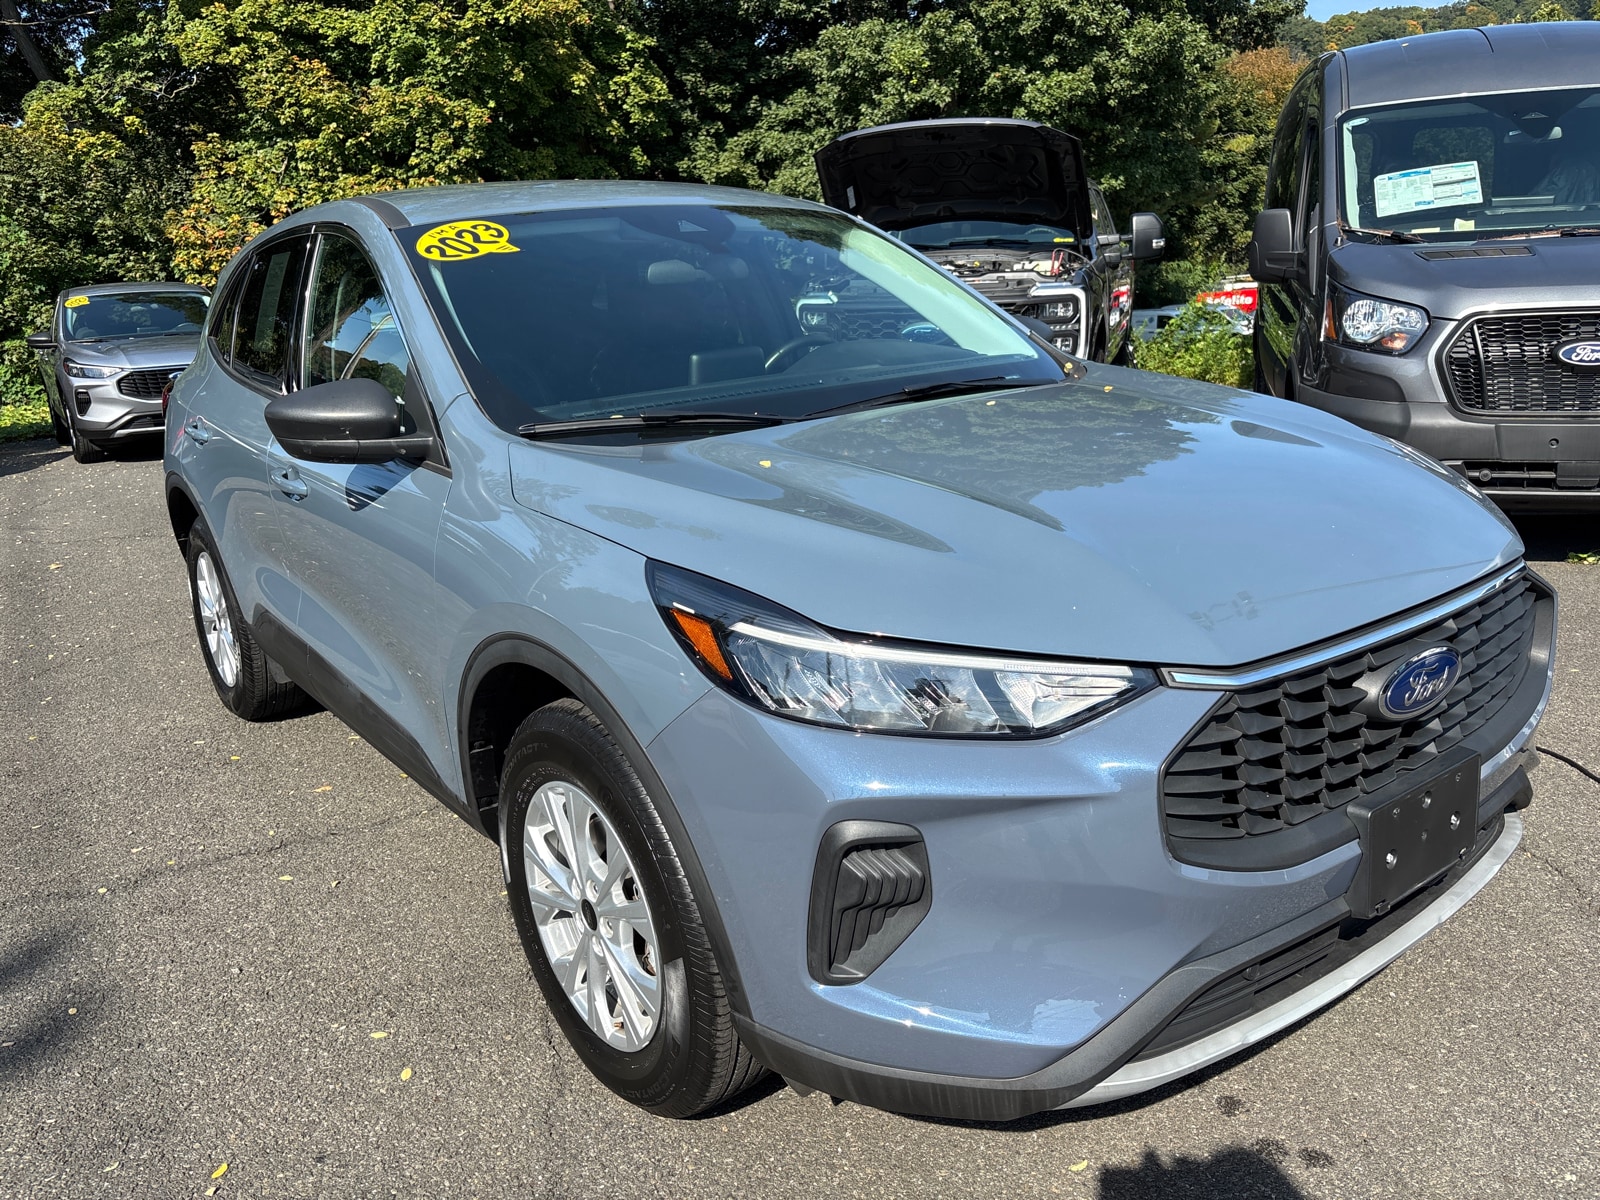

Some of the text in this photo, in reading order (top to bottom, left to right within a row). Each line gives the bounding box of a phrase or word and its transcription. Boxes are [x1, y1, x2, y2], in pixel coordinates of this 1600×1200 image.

[424, 224, 504, 258] 2023
[1571, 345, 1600, 361] For
[1404, 662, 1449, 706] Ford
